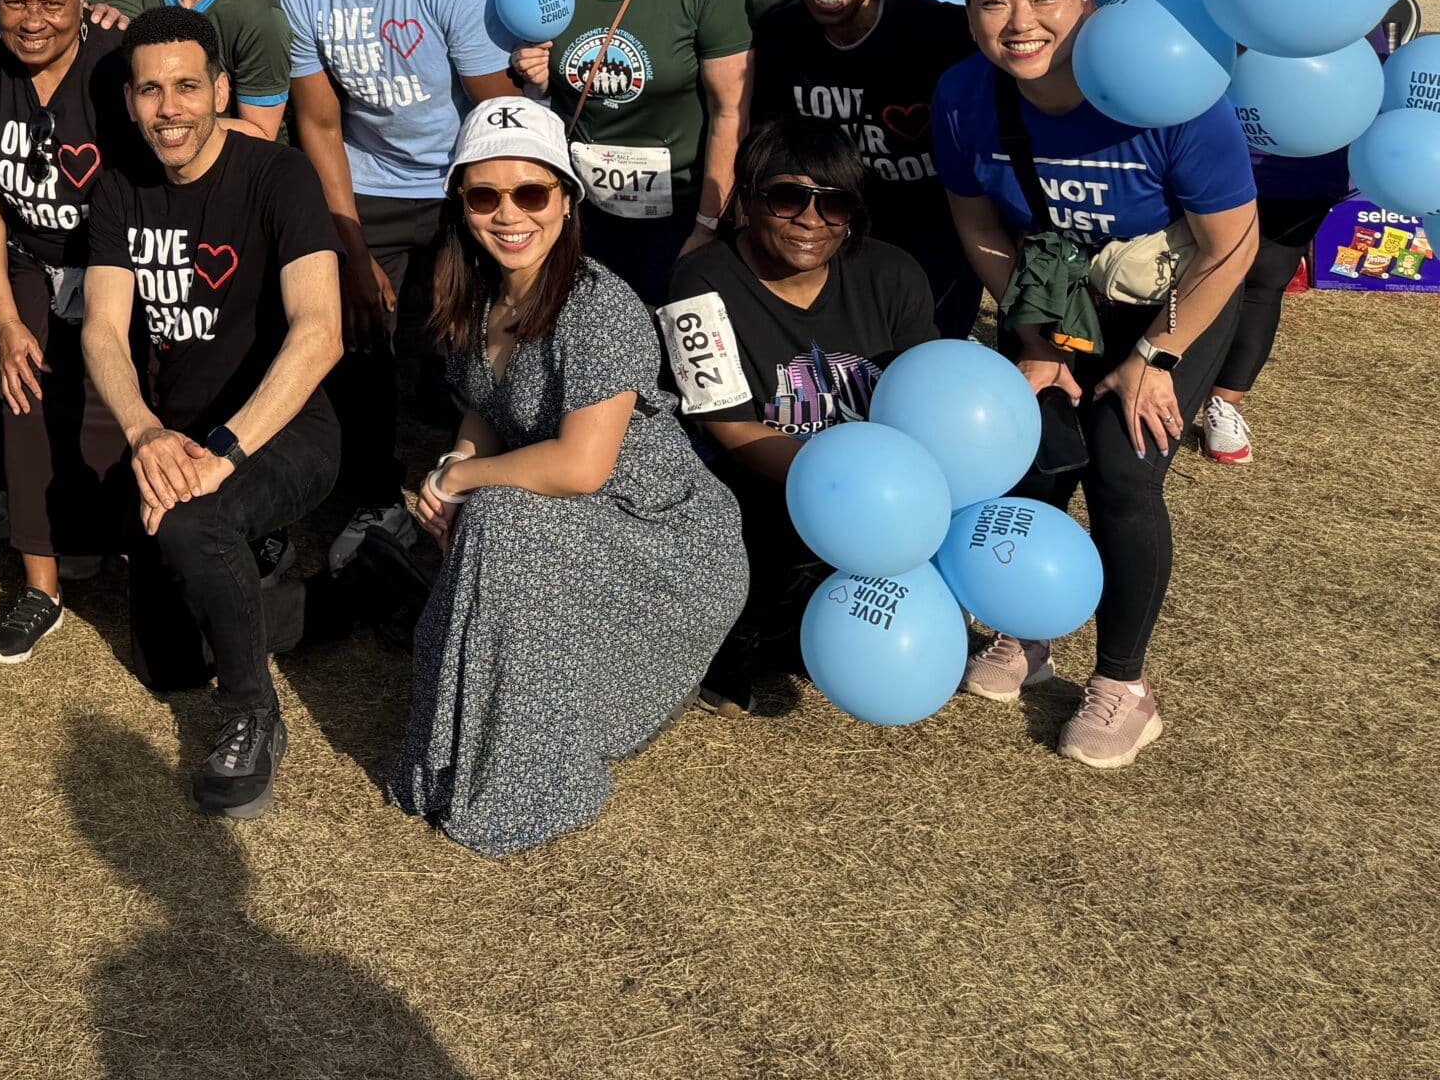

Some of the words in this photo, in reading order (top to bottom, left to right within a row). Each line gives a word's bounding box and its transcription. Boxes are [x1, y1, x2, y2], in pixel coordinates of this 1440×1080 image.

[539, 1, 561, 15] YOUR
[541, 6, 570, 25] SCHOOL
[317, 7, 376, 40] LOVE
[324, 41, 387, 74] YOUR
[620, 41, 640, 68] PEACE
[592, 167, 658, 192] 2017
[1040, 176, 1109, 206] NOT
[1049, 206, 1116, 234] UST
[127, 227, 190, 266] LOVE
[1168, 288, 1178, 334] KANGOL
[676, 312, 723, 389] 2189
[763, 419, 840, 435] GOSPE
[969, 504, 999, 549] SCHOOL
[990, 505, 1018, 536] YOUR
[1010, 506, 1036, 538] LOVE
[853, 585, 898, 614] YOUR
[849, 601, 893, 630] LOVE
